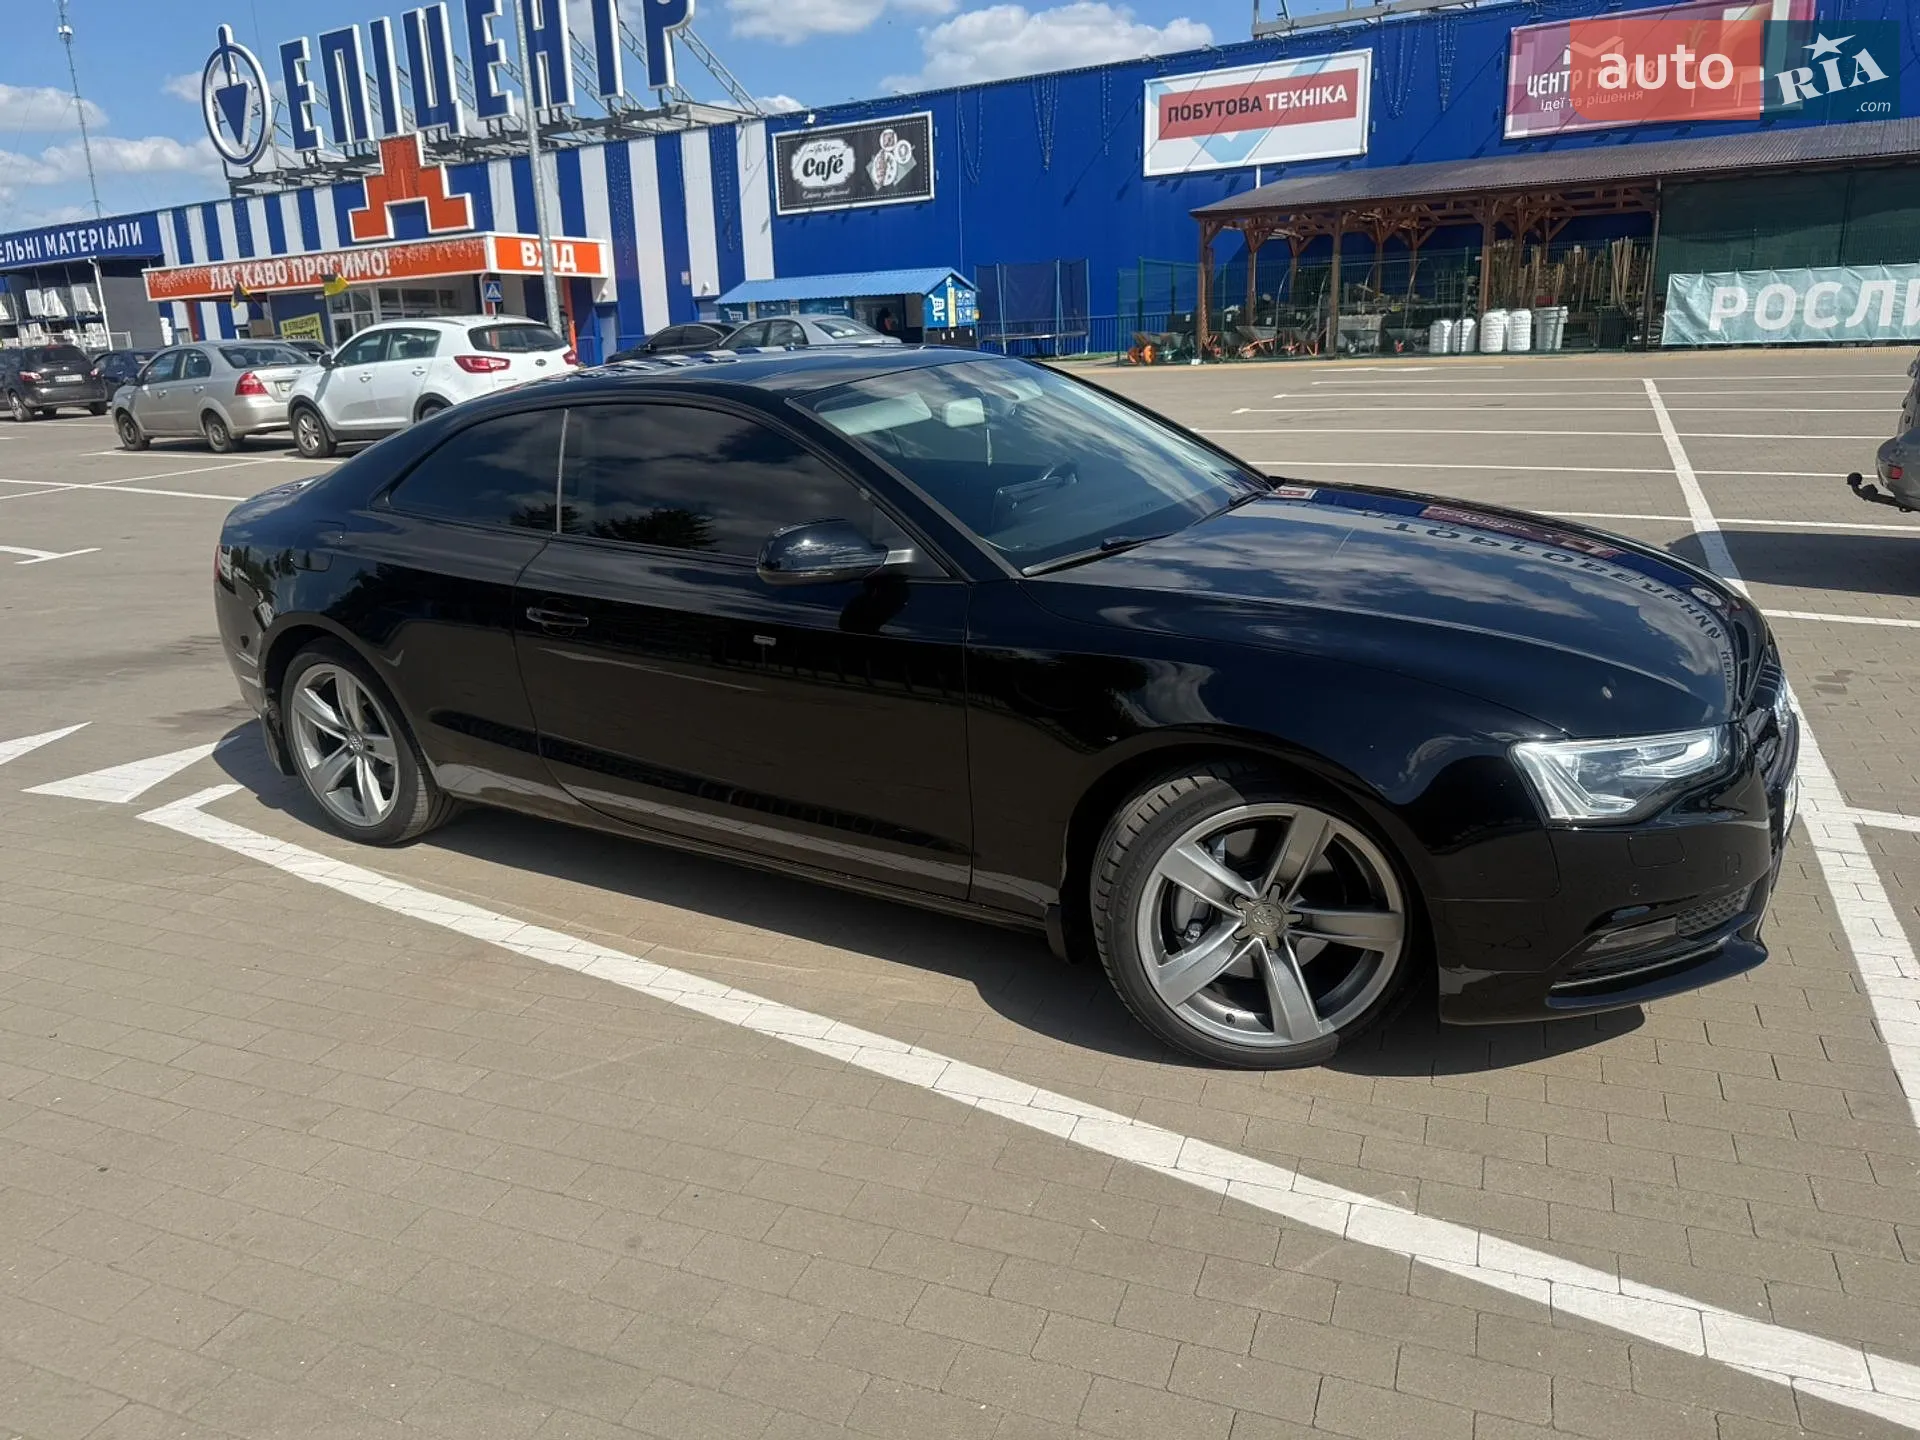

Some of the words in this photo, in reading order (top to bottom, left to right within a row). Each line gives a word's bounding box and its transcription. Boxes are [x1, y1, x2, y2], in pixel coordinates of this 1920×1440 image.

[1526, 69, 1583, 97] ЦЕНТР
[1168, 96, 1263, 123] ПОБУТОВА
[1266, 84, 1348, 111] ТЕХНІКА
[1587, 90, 1644, 108] рішення
[802, 153, 844, 181] Café
[44, 221, 143, 256] МАТЕРІАЛИ
[210, 260, 288, 290] ЛАСКАВО
[292, 249, 391, 283] ПРОСИМО!
